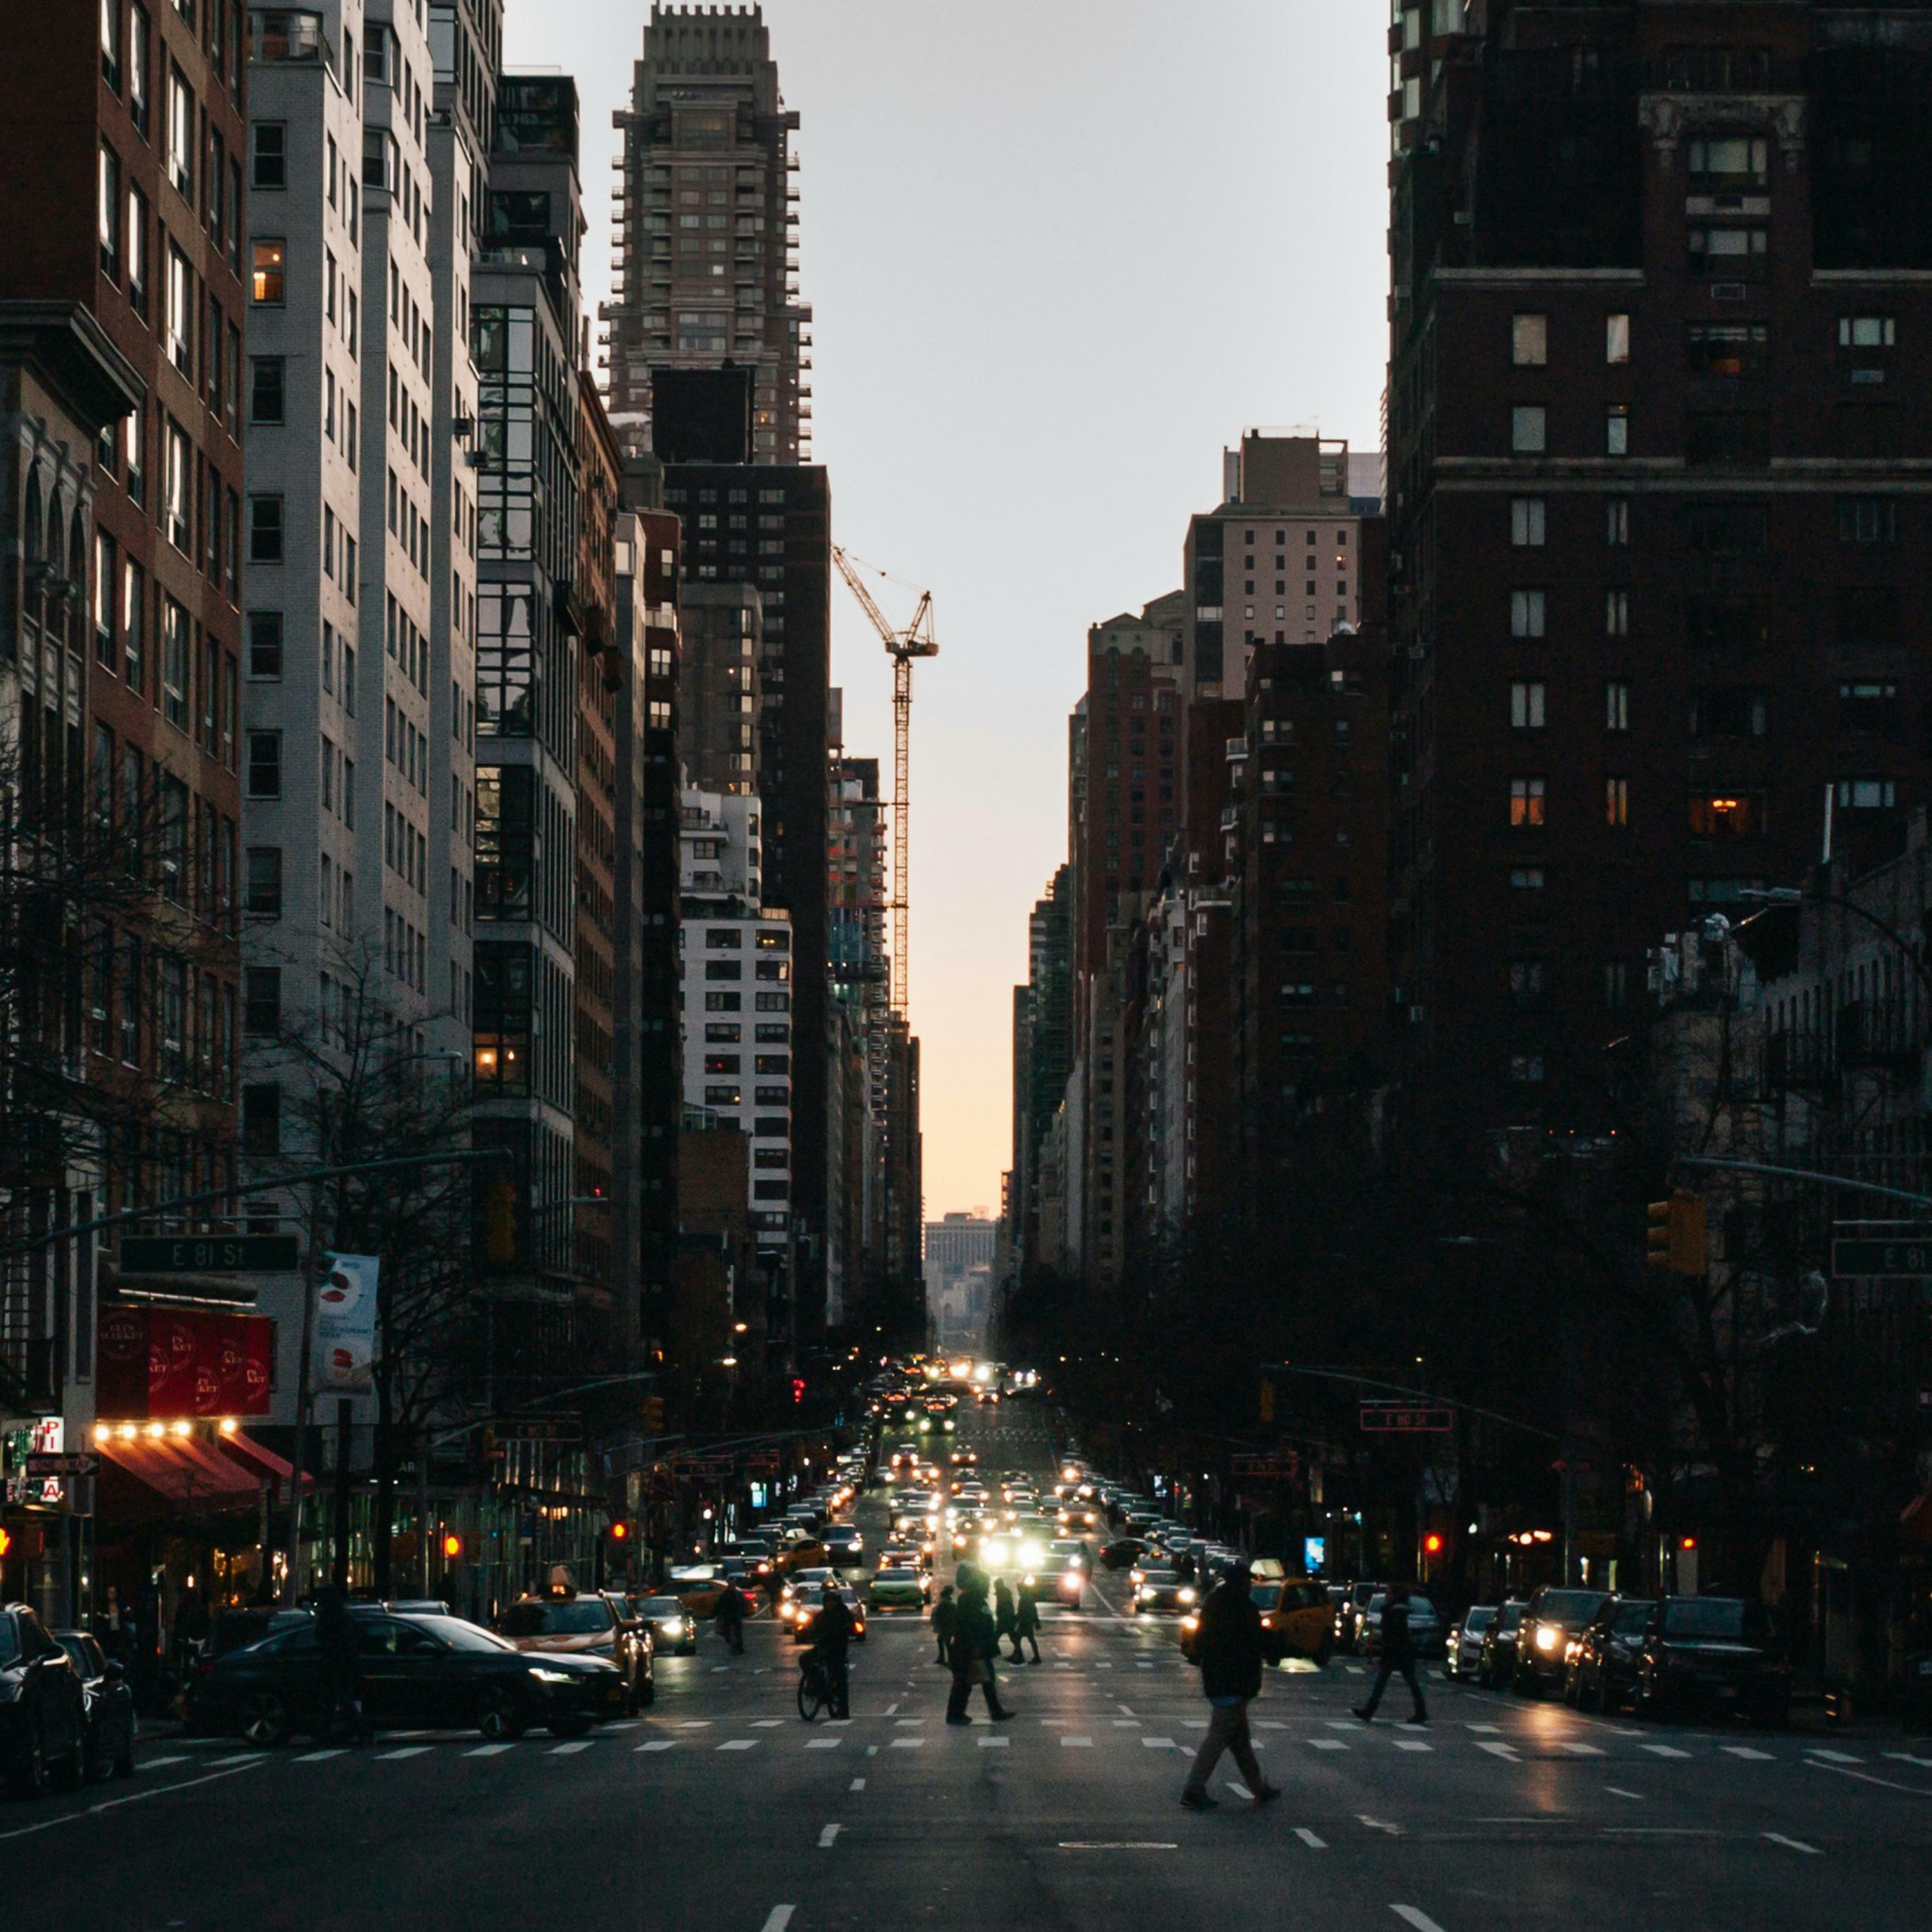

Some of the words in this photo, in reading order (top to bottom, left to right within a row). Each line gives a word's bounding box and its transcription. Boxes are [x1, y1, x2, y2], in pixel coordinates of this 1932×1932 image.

[173, 1244, 185, 1266] E
[195, 1244, 213, 1266] 81
[225, 1244, 243, 1265] St
[1884, 1247, 1897, 1268] E
[1907, 1247, 1925, 1269] 81
